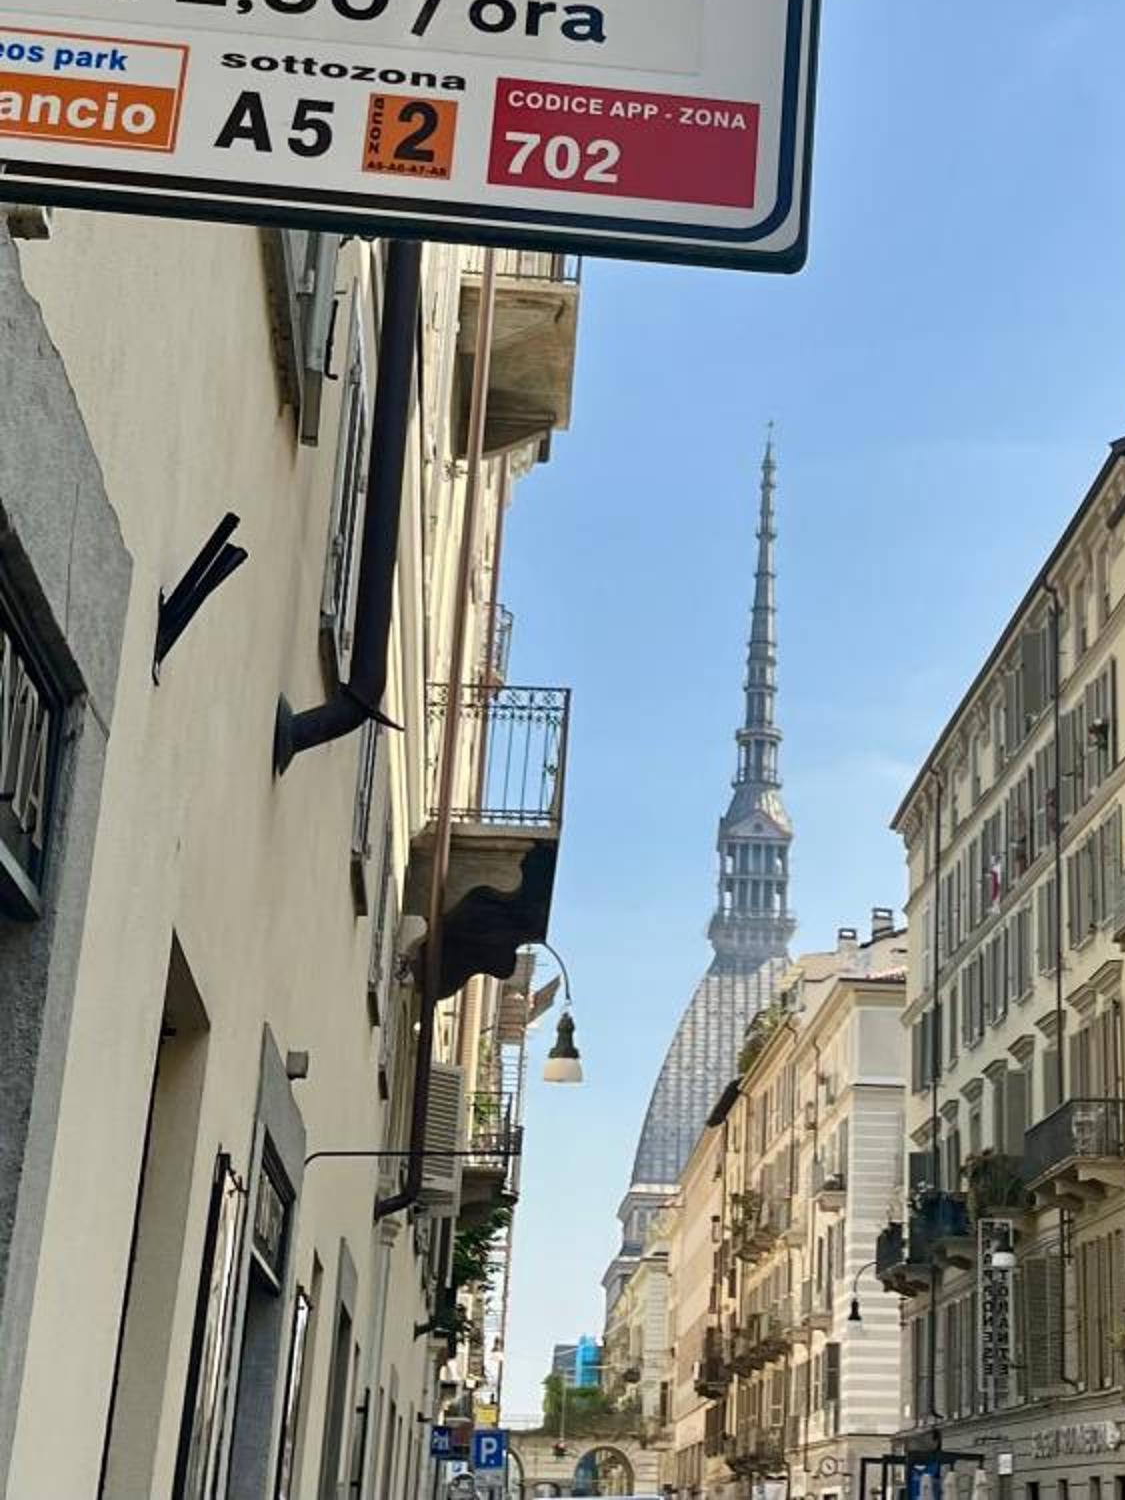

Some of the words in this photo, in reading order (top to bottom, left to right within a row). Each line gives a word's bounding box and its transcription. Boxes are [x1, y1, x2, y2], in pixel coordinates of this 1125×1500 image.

[53, 48, 128, 71] park
[221, 53, 466, 91] sottozona
[214, 90, 334, 158] A5
[368, 98, 384, 154] zona
[394, 101, 438, 162] 2
[508, 90, 603, 116] CODICE
[609, 101, 658, 121] APP
[679, 107, 747, 130] ZONA
[505, 131, 621, 183] 702
[481, 1438, 497, 1464] P
